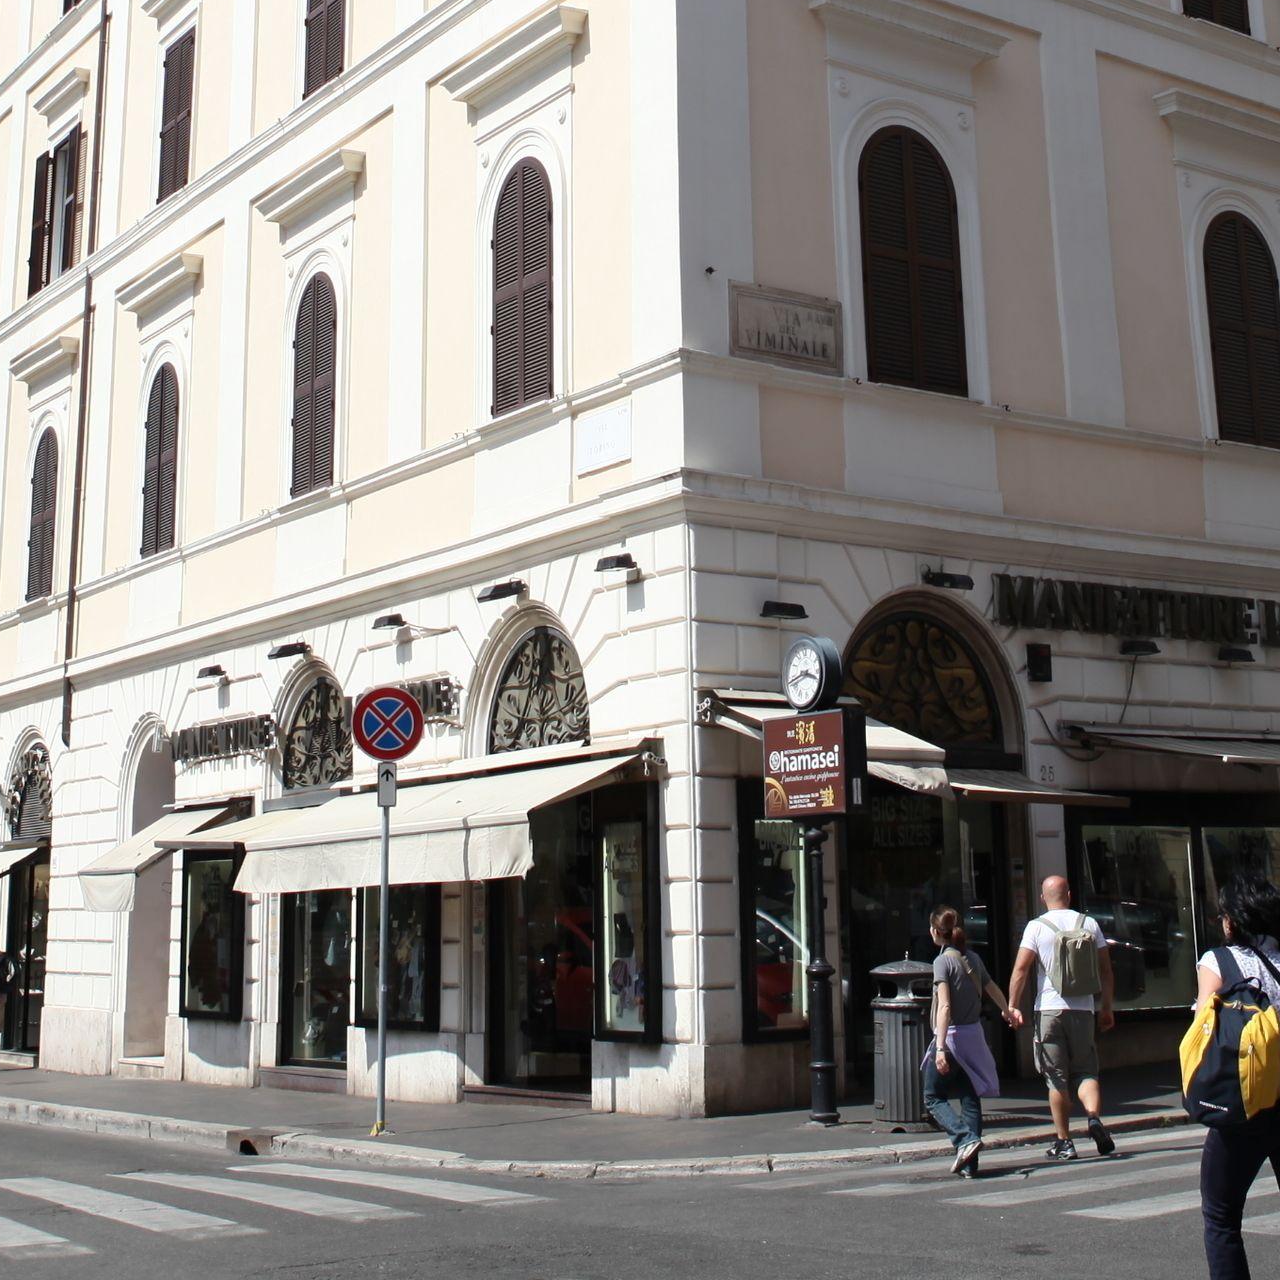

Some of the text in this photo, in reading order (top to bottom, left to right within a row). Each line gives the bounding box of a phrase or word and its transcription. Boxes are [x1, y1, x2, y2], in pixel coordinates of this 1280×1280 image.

[771, 306, 802, 328] VIA
[745, 328, 830, 358] VIMINALE
[992, 573, 1258, 645] MANIFATTURE
[780, 744, 840, 773] hamasei
[1040, 764, 1055, 782] 25
